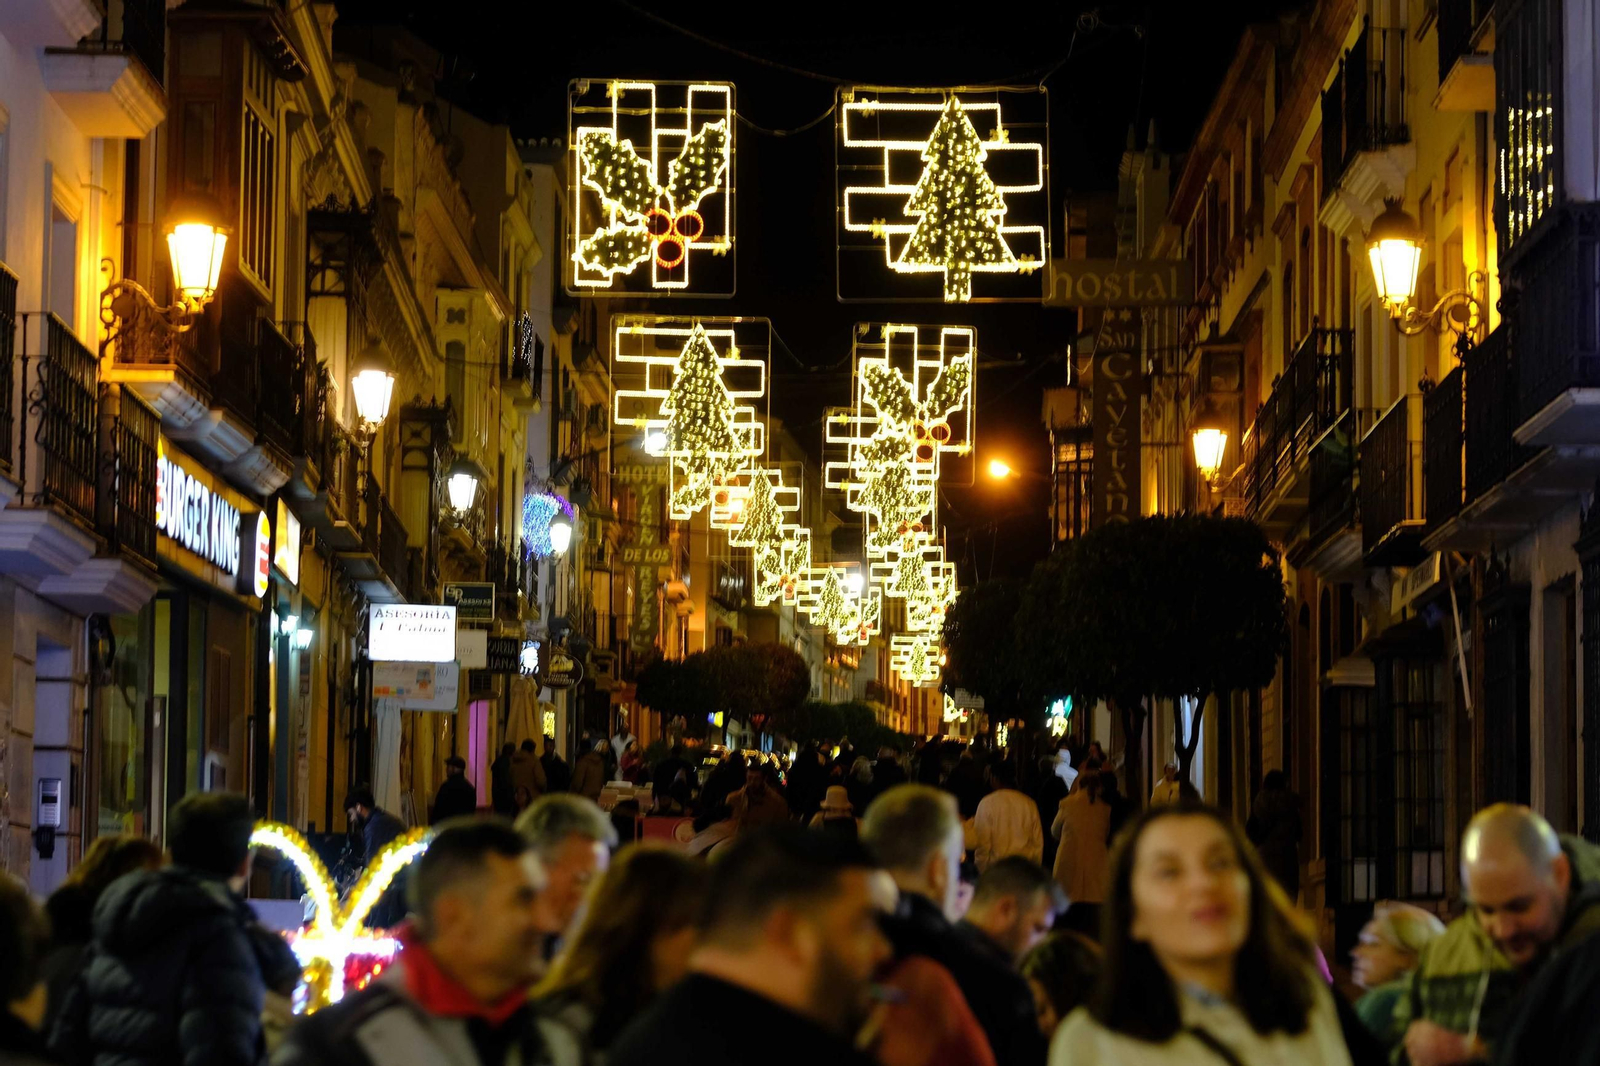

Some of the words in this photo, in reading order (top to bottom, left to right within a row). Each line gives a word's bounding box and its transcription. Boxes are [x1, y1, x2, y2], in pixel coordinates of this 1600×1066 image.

[1051, 265, 1177, 299] hostal
[619, 465, 672, 484] HOTE
[156, 454, 210, 559] BURGER
[210, 491, 240, 577] KING
[624, 550, 641, 562] DE
[645, 549, 670, 562] LOS
[640, 566, 653, 631] REYES
